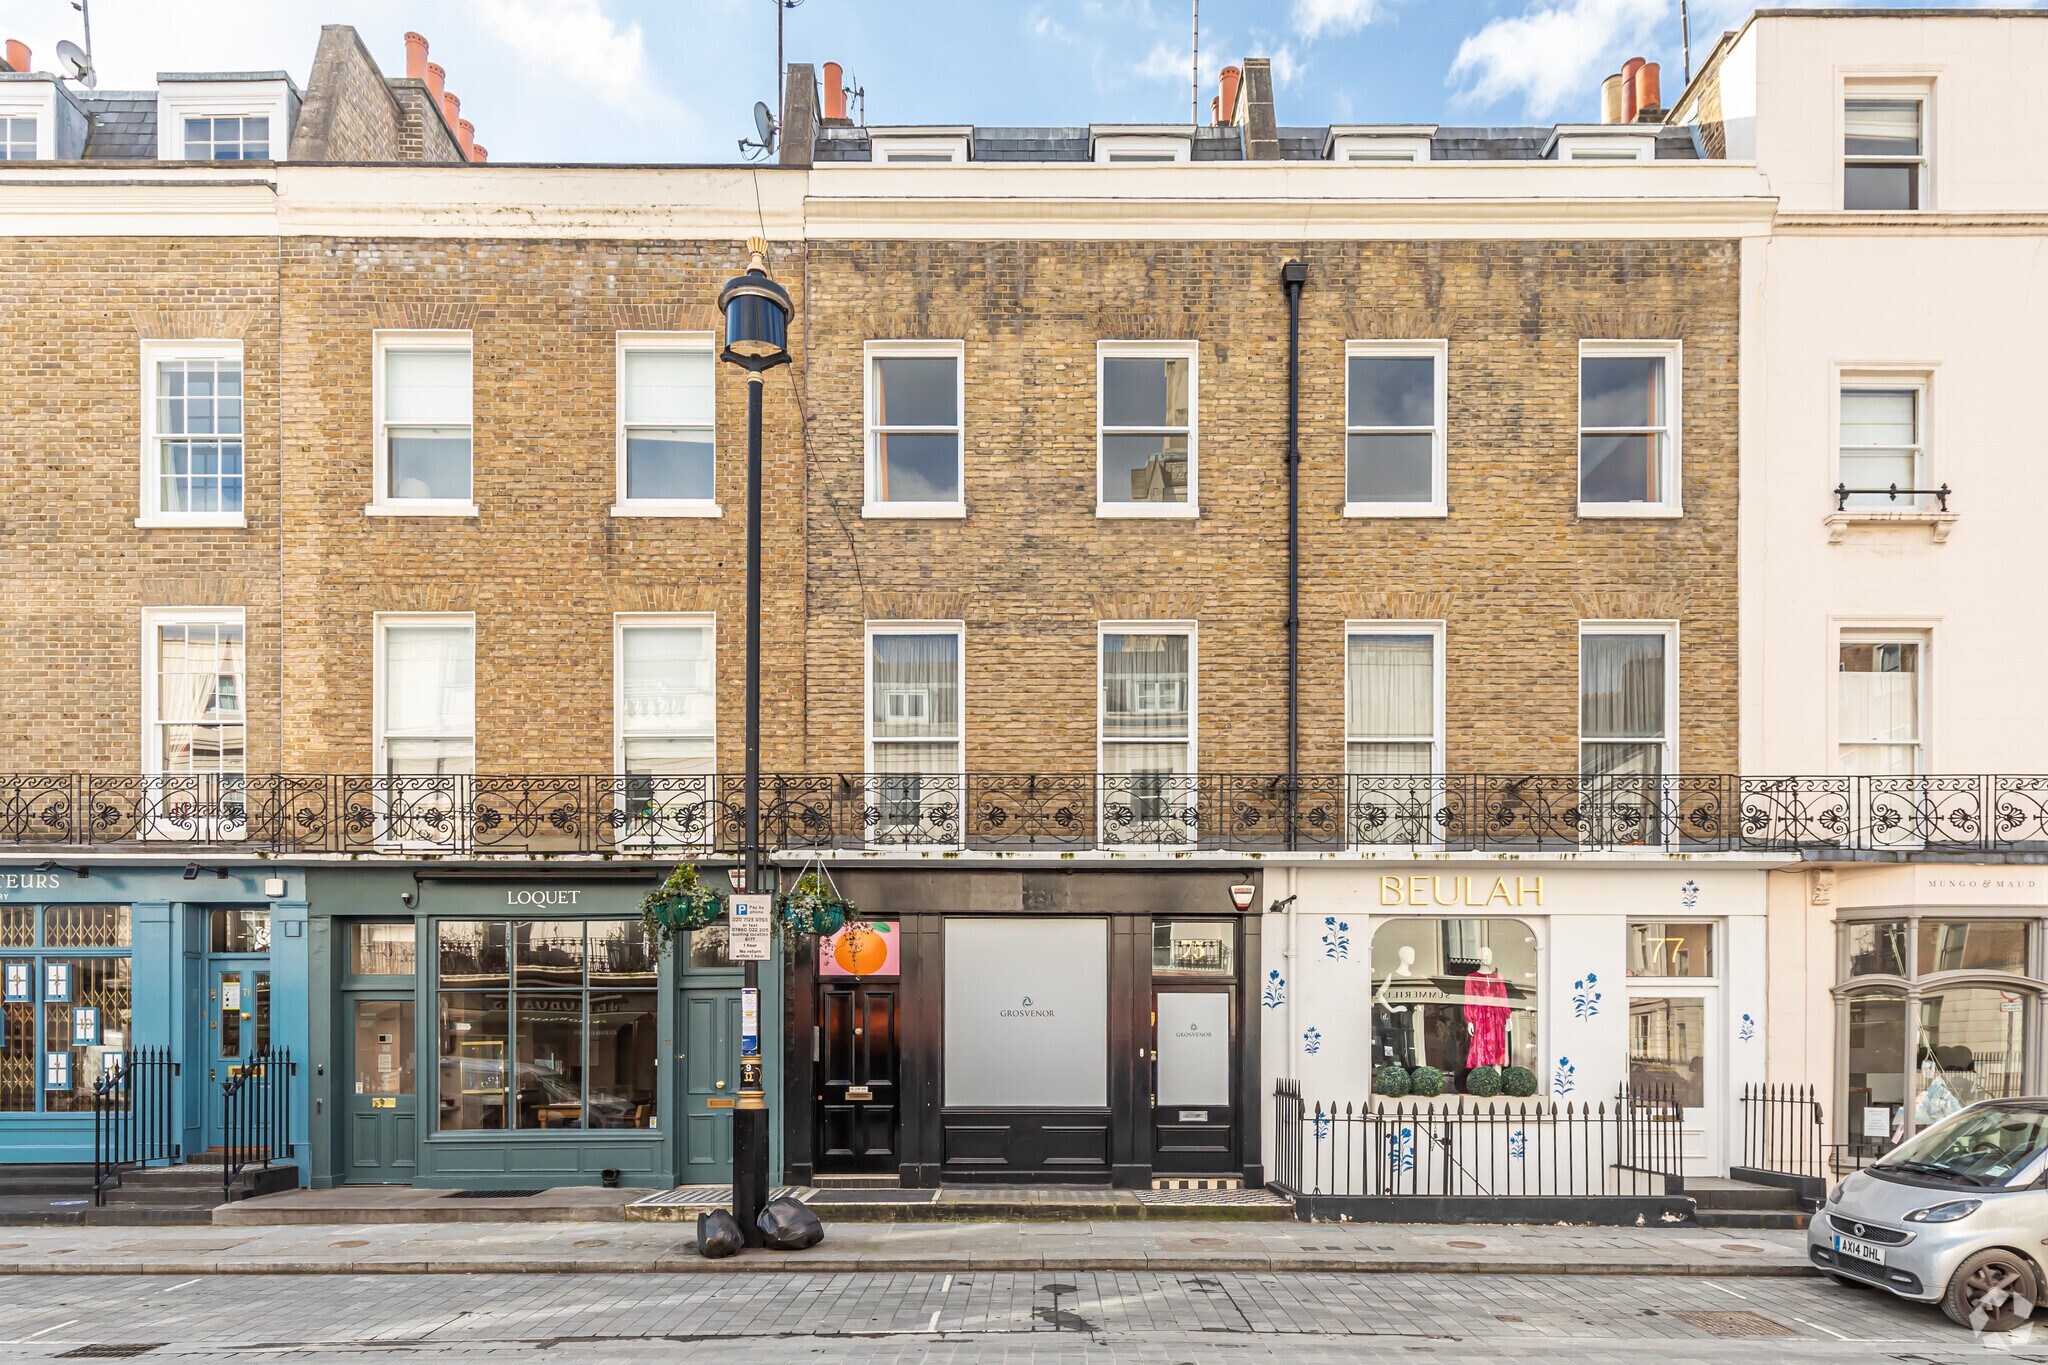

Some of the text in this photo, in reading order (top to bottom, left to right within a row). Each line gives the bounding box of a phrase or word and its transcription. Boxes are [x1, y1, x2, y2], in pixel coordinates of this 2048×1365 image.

[1380, 875, 1544, 906] BEULAH
[1928, 879, 2036, 888] MUNGO & MAUD
[507, 890, 581, 909] LOQUET
[1181, 940, 1205, 959] 75
[1646, 937, 1685, 964] 77
[79, 1018, 93, 1030] 10
[745, 1063, 752, 1072] 9
[1842, 1239, 1881, 1262] AX14 DHL
